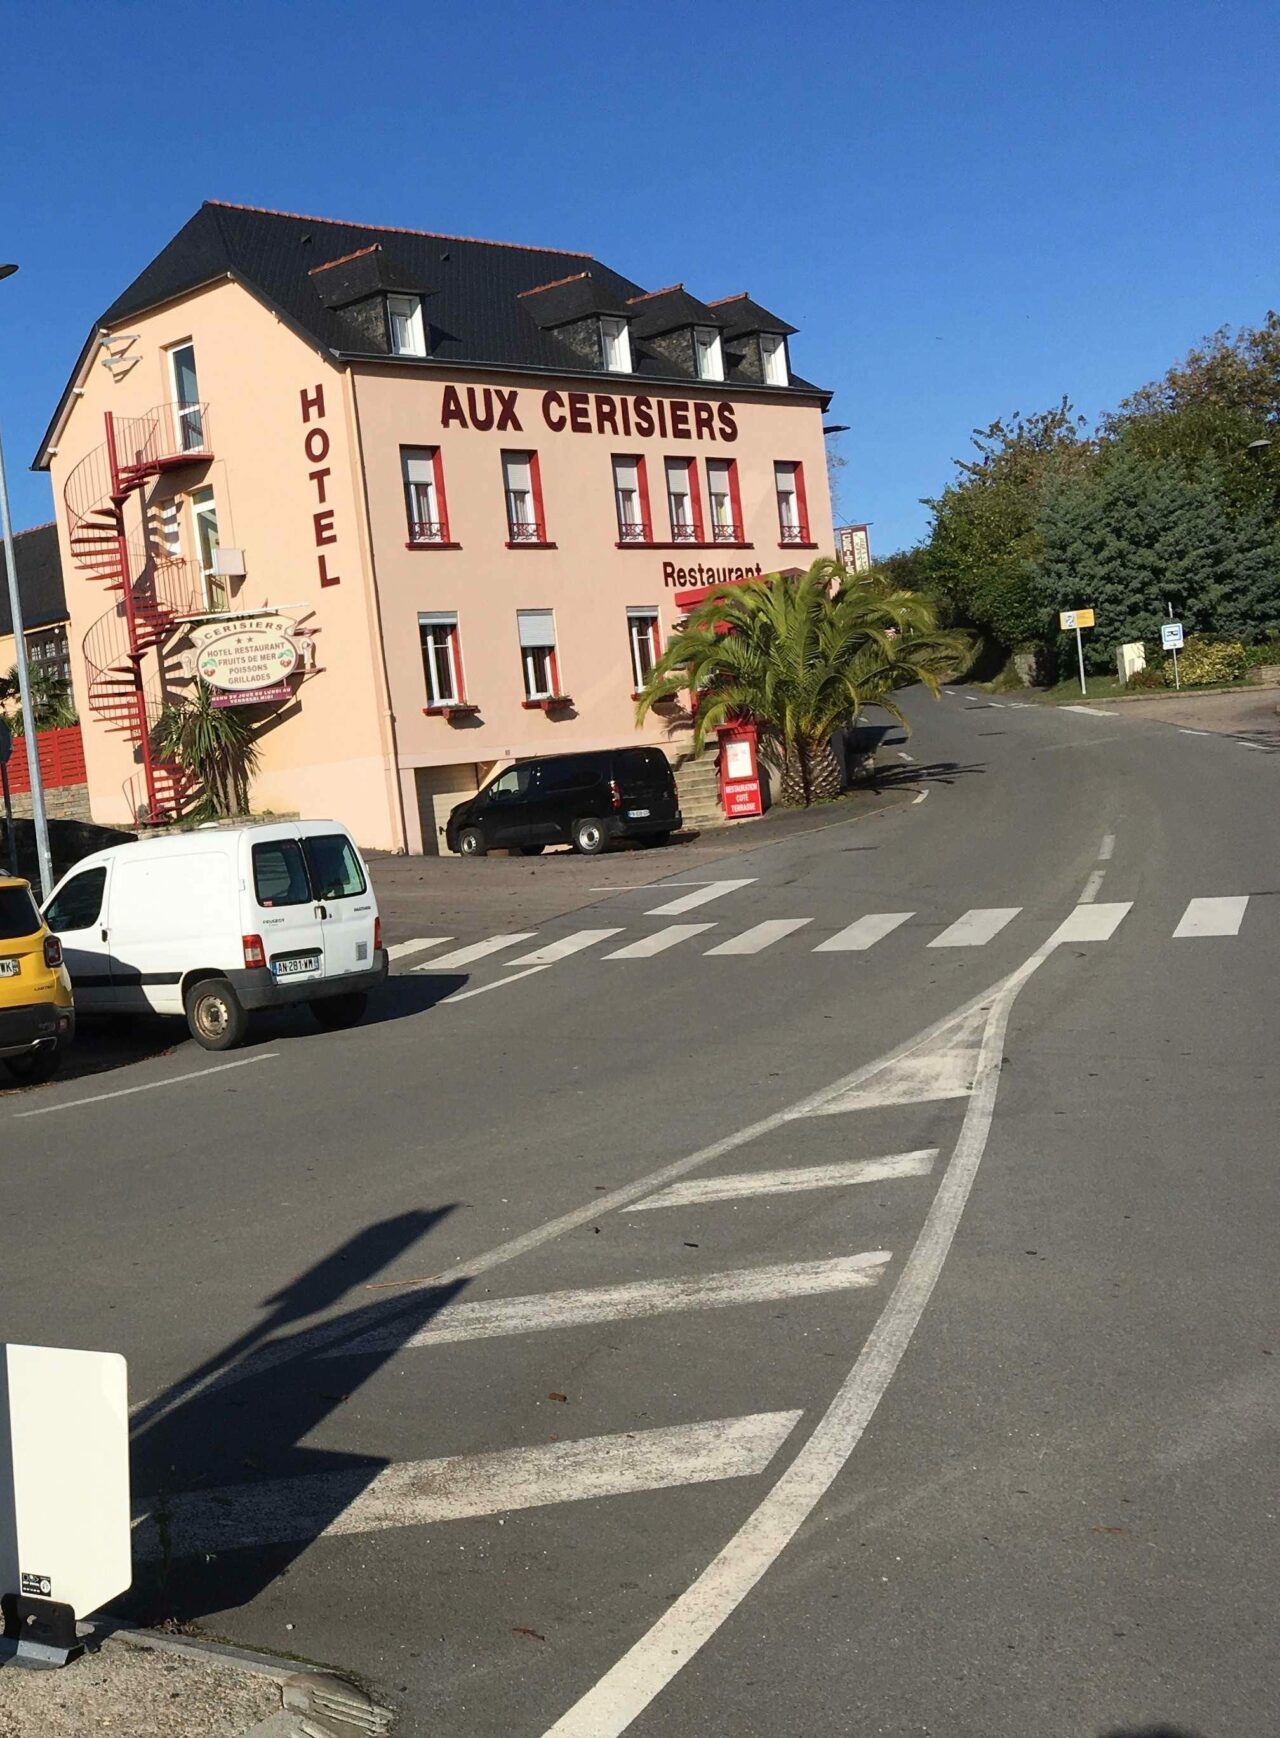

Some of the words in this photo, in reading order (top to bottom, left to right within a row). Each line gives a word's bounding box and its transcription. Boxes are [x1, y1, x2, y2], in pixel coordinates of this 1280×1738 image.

[440, 384, 522, 433] AUX
[543, 391, 739, 443] CERISIERS
[299, 383, 340, 589] HOTEL
[663, 561, 762, 587] Restaurant
[204, 621, 284, 640] CERISIERS
[207, 648, 232, 658] HOTEL
[235, 642, 285, 655] RESTAURANT
[218, 656, 246, 667] FRUITS
[248, 655, 258, 663] DE
[260, 653, 277, 661] MER
[229, 663, 268, 675] POISSONS
[228, 673, 271, 685] GRILLADES
